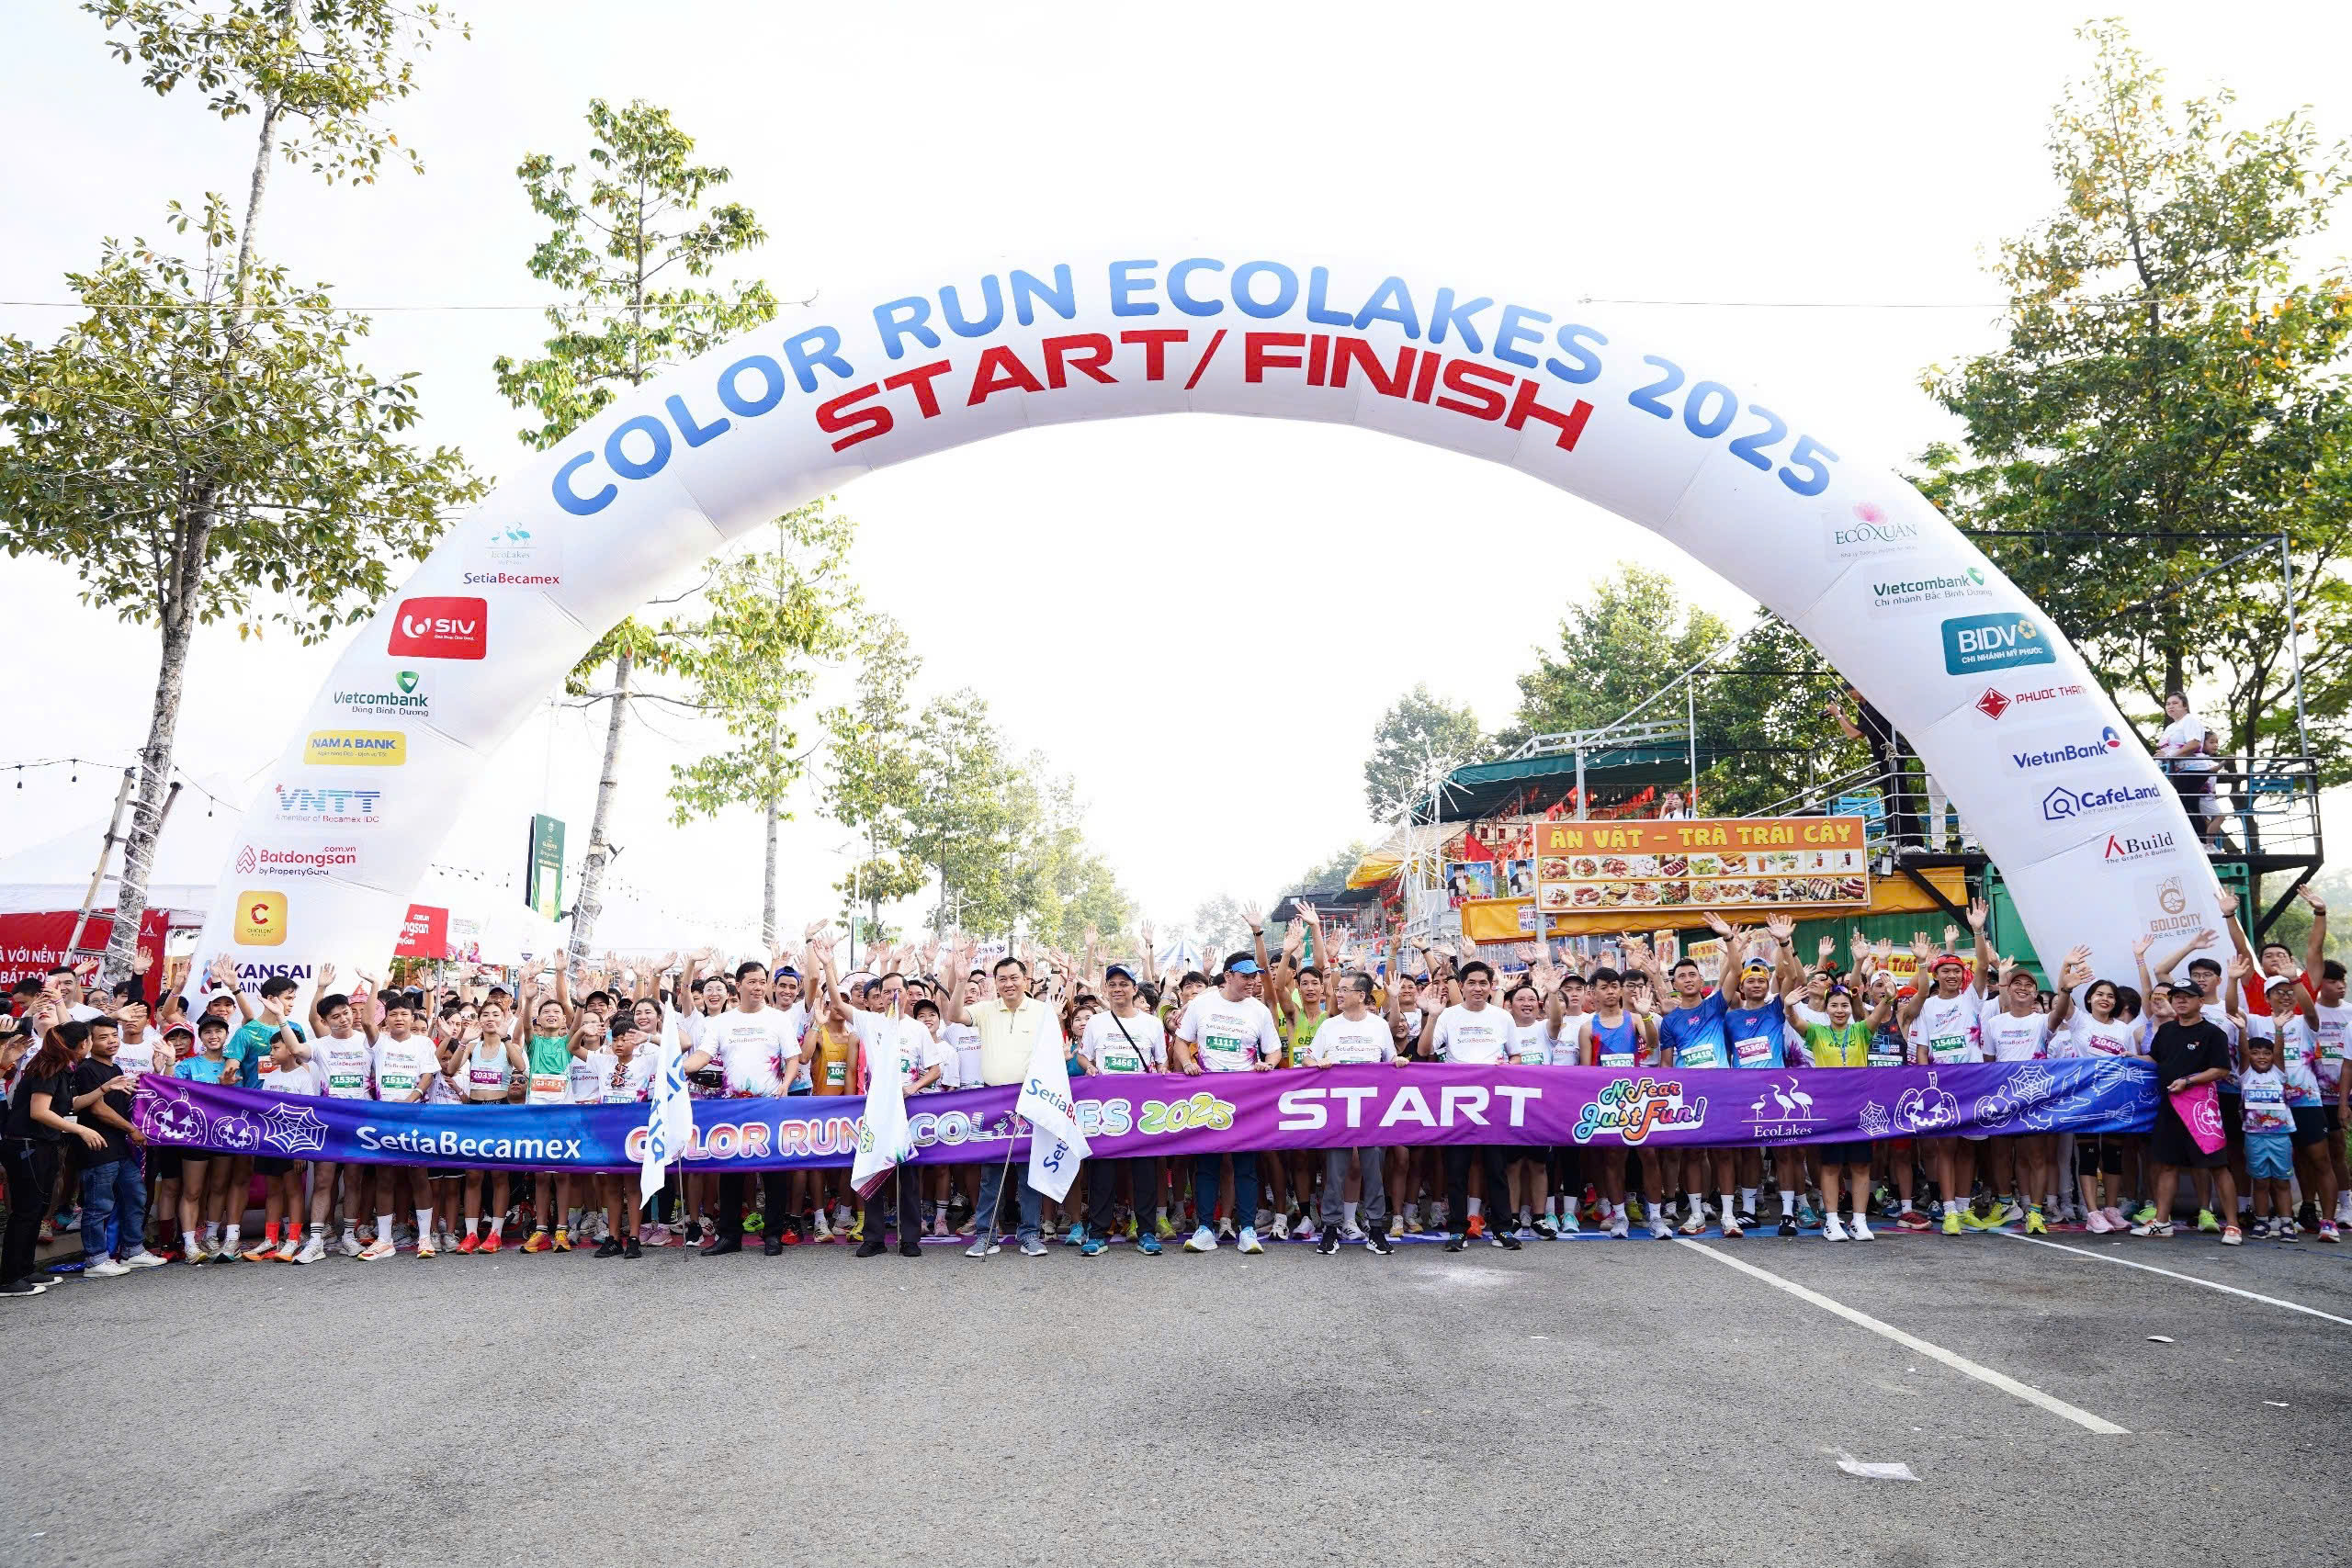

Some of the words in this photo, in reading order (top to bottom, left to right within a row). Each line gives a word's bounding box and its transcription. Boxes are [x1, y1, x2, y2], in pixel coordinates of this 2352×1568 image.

[552, 325, 854, 515] COLOR
[873, 264, 1077, 360] RUN
[1108, 257, 1609, 384] ECOLAKES
[1628, 355, 1840, 497] 2025
[1244, 332, 1594, 452] FINISH
[463, 572, 560, 585] SetiaBecamex
[1873, 574, 1970, 596] Vietcombank
[1874, 599, 1890, 607] Chi
[435, 618, 476, 635] SIV
[1958, 625, 2017, 654] BIDV
[1962, 655, 1975, 664] CHI
[1977, 650, 2006, 662] NHÁNH
[334, 691, 429, 707] Vietcombank
[312, 738, 341, 749] NAM
[343, 739, 352, 749] A
[355, 739, 397, 750] BANK
[2012, 740, 2109, 769] VietinBank
[2081, 784, 2162, 808] CafeLand
[1550, 826, 1584, 850] ĂN
[1592, 825, 1644, 852] VẶT
[1678, 822, 1728, 847] TRÀ
[1736, 820, 1794, 846] TRÁI
[1804, 818, 1852, 843] CÂY
[260, 849, 356, 867] Batdongsan
[2120, 853, 2143, 862] Grade
[2151, 847, 2177, 856] Builders
[258, 867, 269, 876] by
[269, 866, 329, 877] PropertyGuru
[7, 945, 30, 963] VỚI
[33, 944, 56, 964] NỀN
[1212, 1037, 1234, 1047] 1111
[1740, 1043, 1766, 1055] 25360
[1936, 1038, 1962, 1047] 15463
[2096, 1038, 2120, 1052] 20450
[334, 1076, 361, 1084] 15396
[472, 1072, 498, 1080] 20338
[2249, 1090, 2279, 1100] 30170
[1137, 1092, 1237, 1135] 2025
[1278, 1085, 1543, 1131] START
[1753, 1123, 1814, 1138] EcoLakes
[356, 1125, 582, 1160] SetiaBecamex
